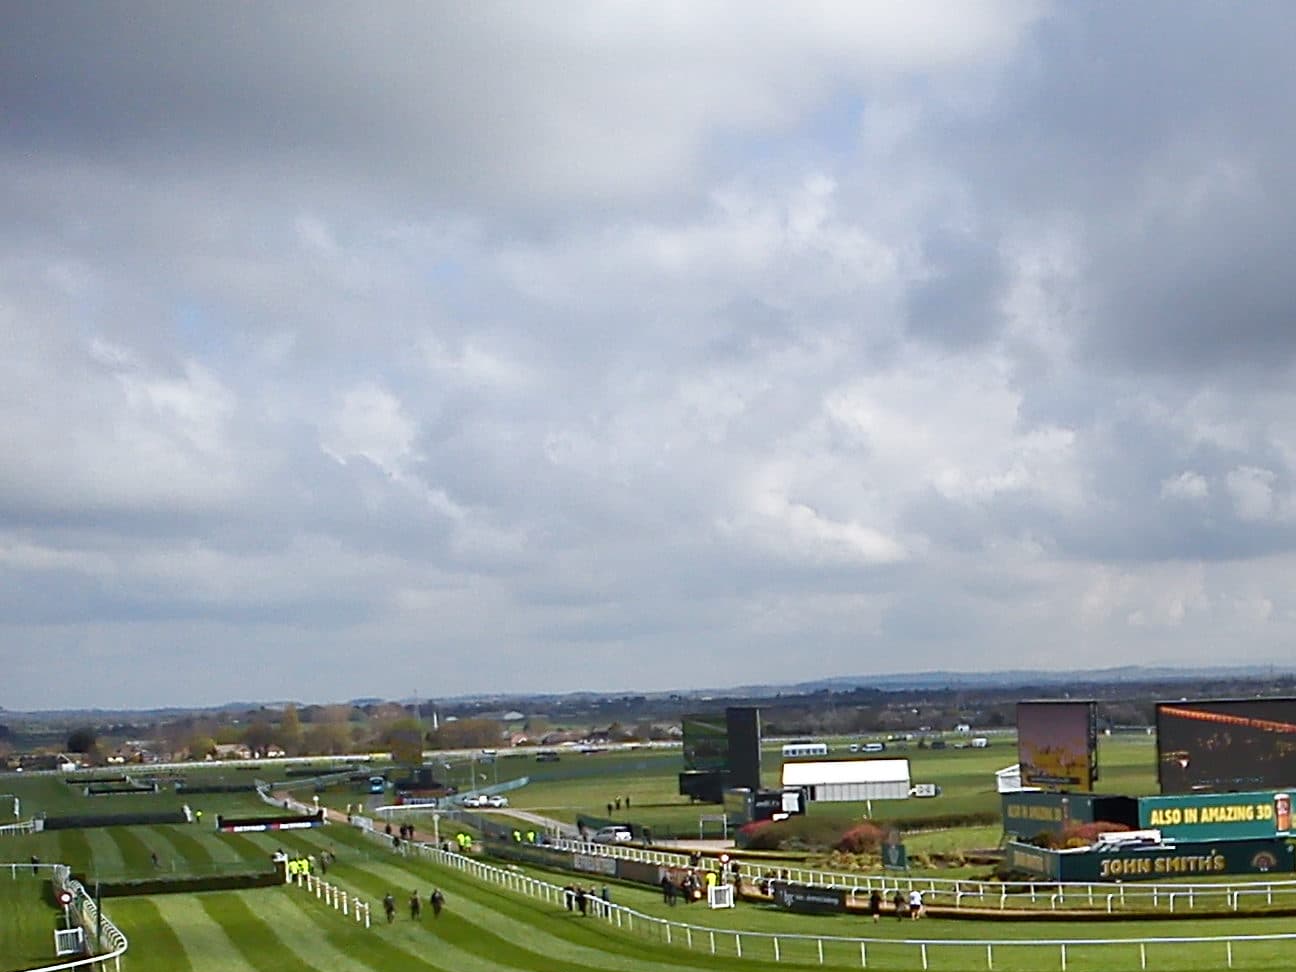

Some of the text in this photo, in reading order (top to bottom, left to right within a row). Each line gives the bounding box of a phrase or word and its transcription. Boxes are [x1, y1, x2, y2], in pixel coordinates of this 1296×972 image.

[1151, 804, 1273, 825] ALSO IN AMAZING 3D
[1100, 849, 1225, 877] JOHN SMITH'S
